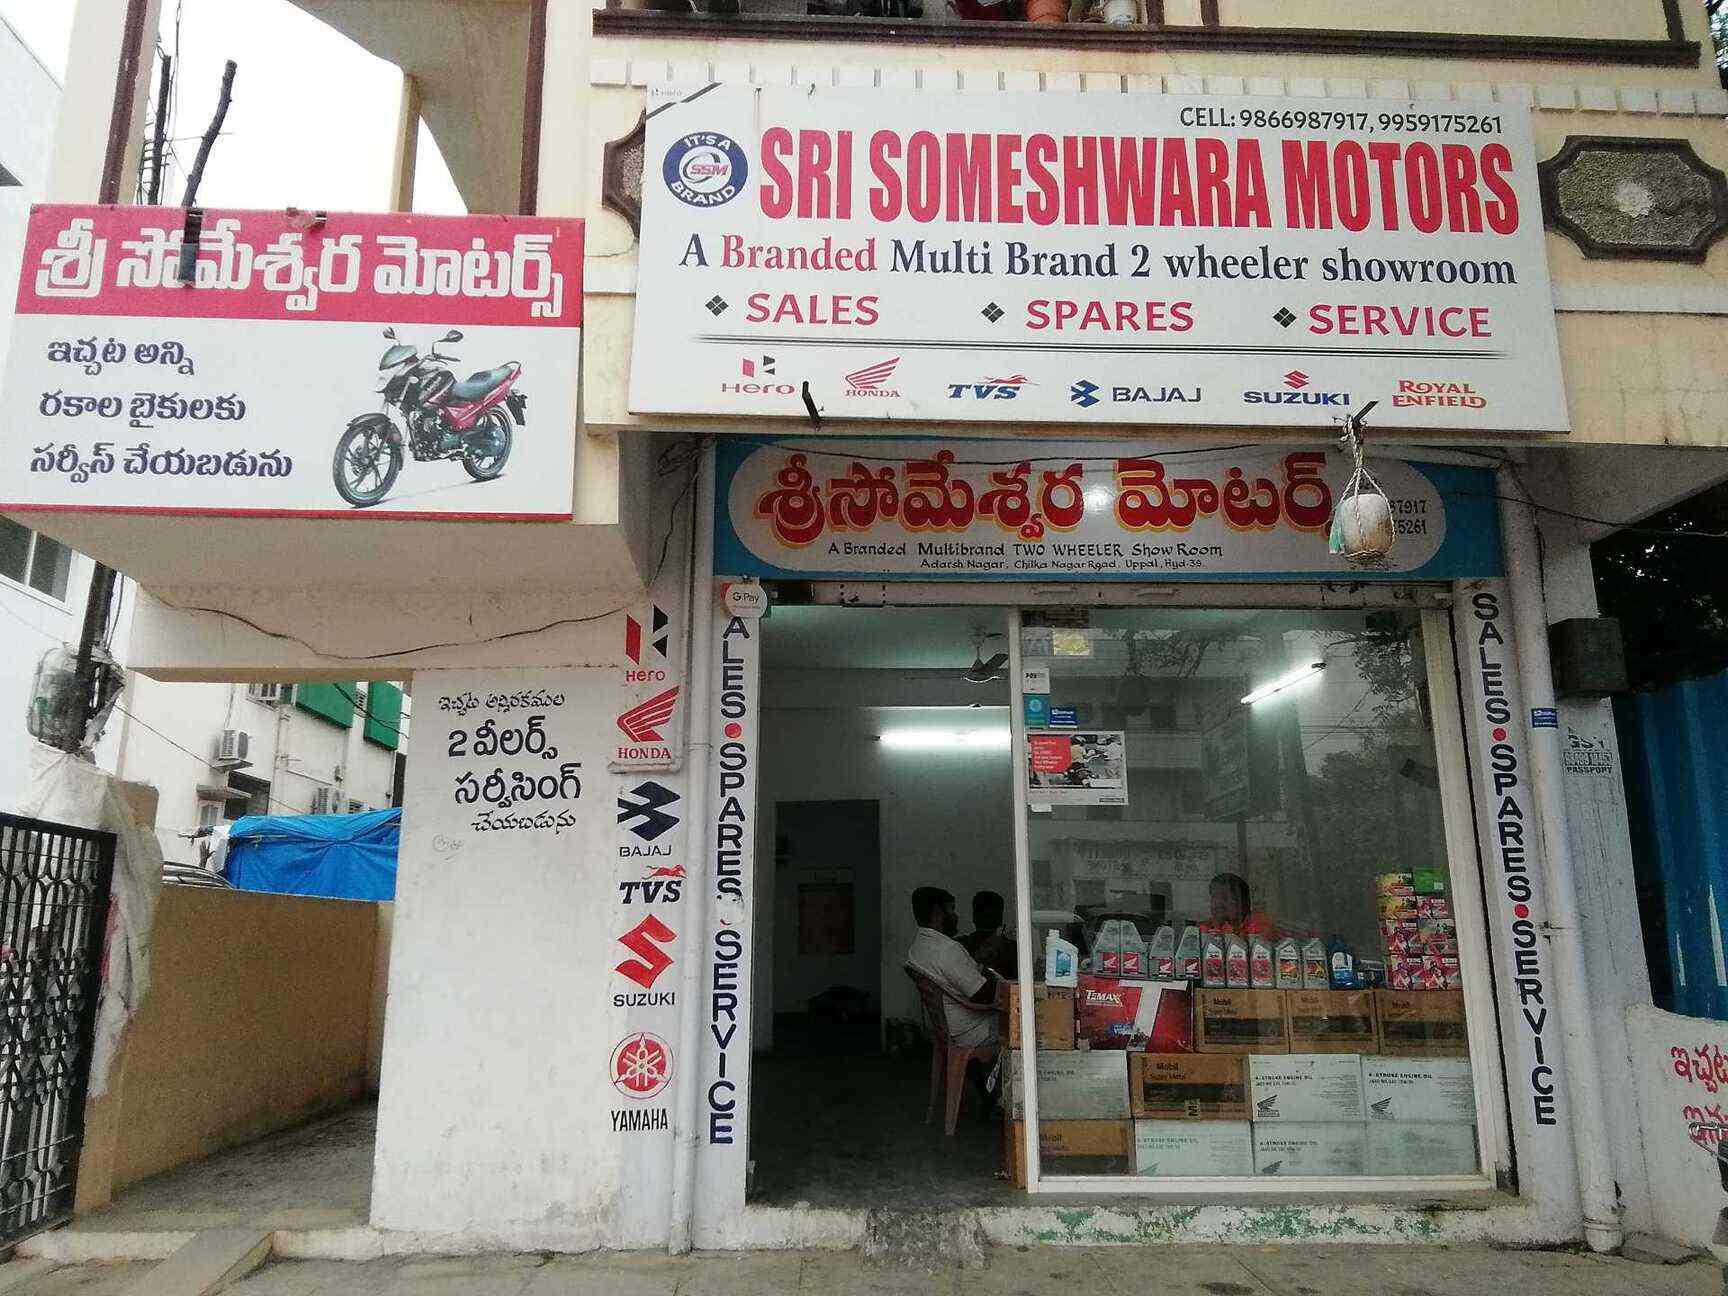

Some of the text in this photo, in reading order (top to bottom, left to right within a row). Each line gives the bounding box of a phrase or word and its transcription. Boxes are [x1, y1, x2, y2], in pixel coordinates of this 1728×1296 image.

[684, 135, 731, 151] IT'S A
[690, 164, 728, 176] SSM
[760, 127, 1520, 236] SRI SOMESHWARA MOTORS
[671, 181, 735, 204] BRAND
[35, 218, 107, 298] శ్రీ
[678, 233, 1517, 284] A Branded Multi Brand 2 wheeler showroom
[745, 293, 880, 326] SALES
[1026, 300, 1194, 332] SPARES
[1308, 304, 1492, 337] SERVICE
[47, 336, 195, 376] ఇచ్చట అన్ని
[721, 383, 795, 395] Hero
[846, 389, 900, 398] HONDA
[947, 384, 1021, 400] TVS
[1112, 387, 1202, 402] BAJAJ
[1243, 390, 1350, 406] SUZUKI
[1398, 380, 1475, 395] ROYAL
[39, 388, 247, 428] రకాల బైకులకు
[1392, 394, 1488, 408] ENFIELD
[30, 442, 293, 483] సర్వీస్ చేయబడును
[1114, 451, 1335, 540] మోటర్
[827, 542, 1224, 558] A Branded Multibrand TWO WHEELER Show Room
[920, 558, 964, 569] Adarsh
[1051, 560, 1087, 571] Nagar
[720, 616, 751, 719] ALES
[1472, 593, 1511, 724] SALES
[626, 670, 666, 682] Hero
[448, 729, 468, 757] 2
[618, 747, 672, 759] HONDA
[716, 742, 748, 902] SPARES
[1490, 744, 1532, 902] SPARES
[619, 845, 672, 857] BAJAJ
[619, 879, 682, 904] TVS
[613, 992, 676, 1007] SUZUKI
[1512, 919, 1557, 1126] SERVICE
[707, 929, 743, 1145] SERVICE
[610, 1108, 669, 1132] YAMAHA
